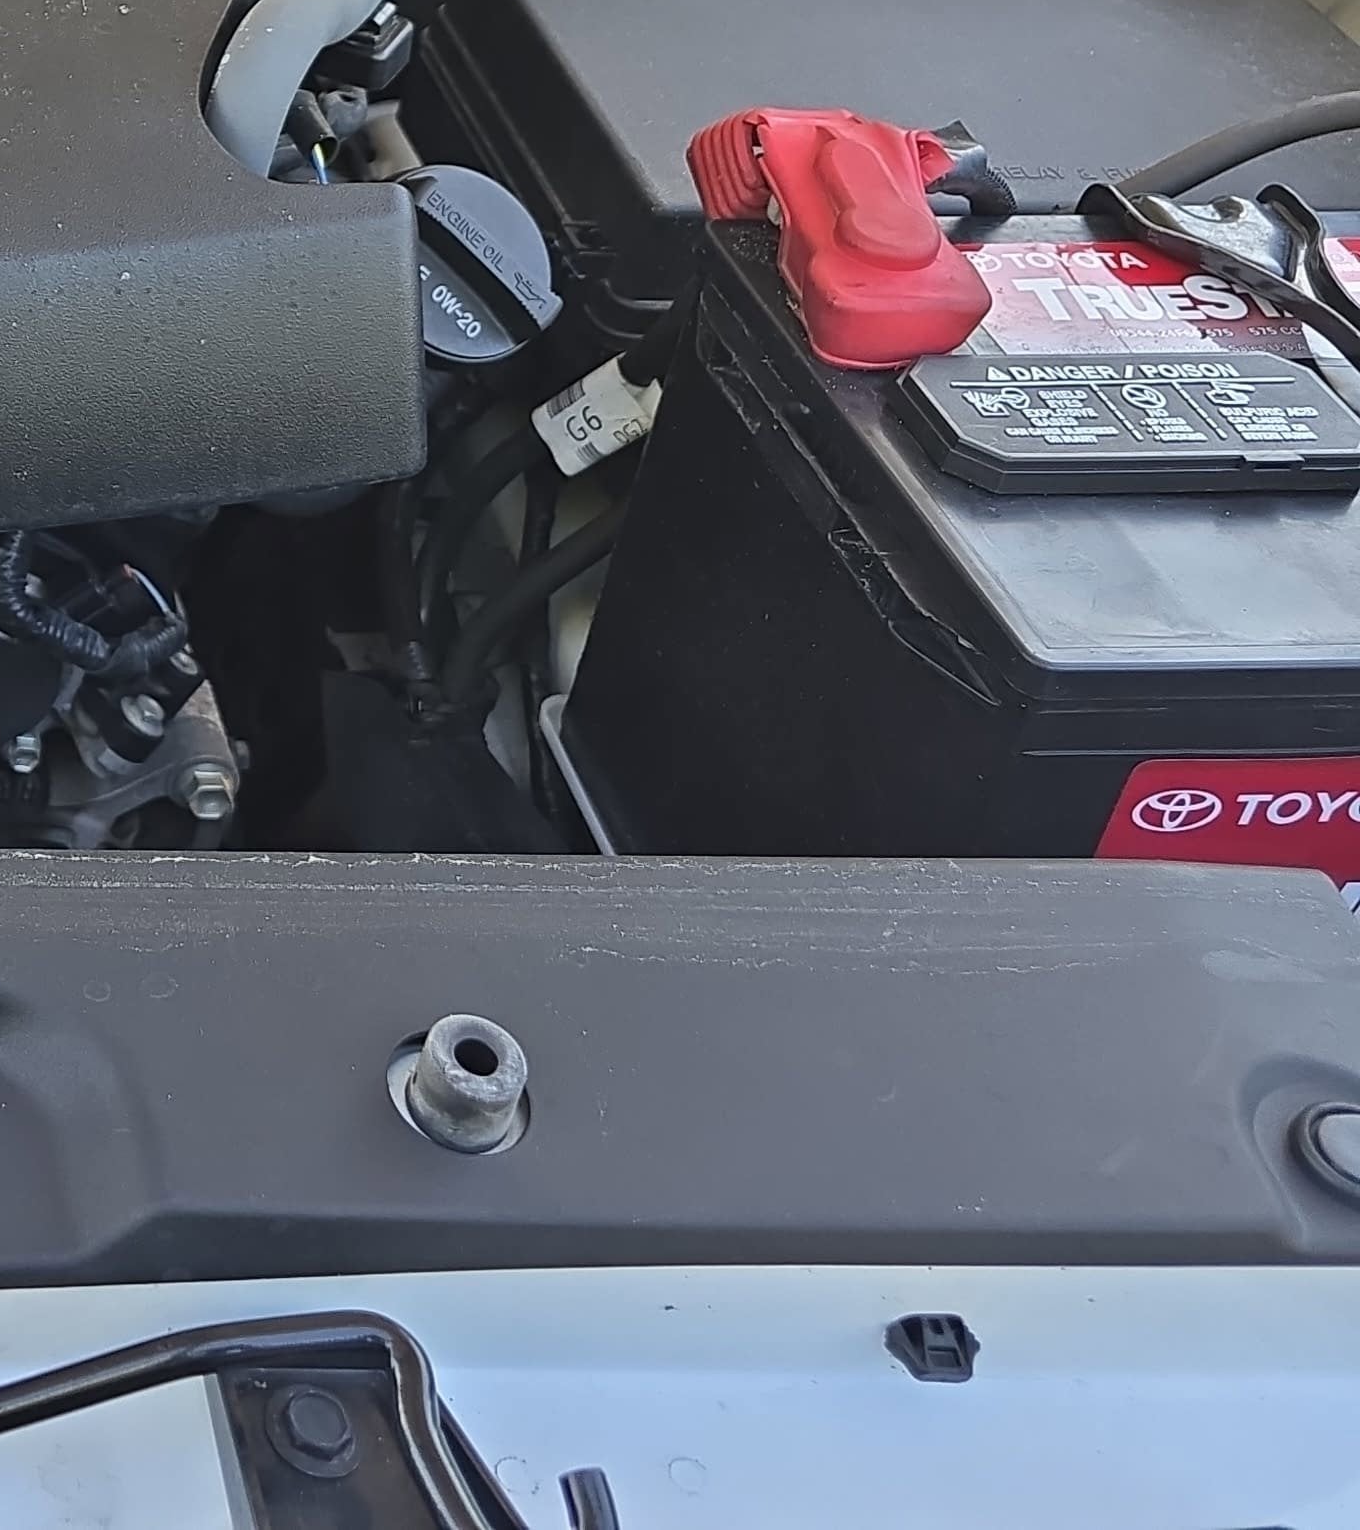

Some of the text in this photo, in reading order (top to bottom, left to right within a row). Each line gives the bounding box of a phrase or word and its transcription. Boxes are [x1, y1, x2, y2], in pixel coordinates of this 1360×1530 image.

[427, 189, 504, 274] ENGINE OIL
[1002, 251, 1149, 270] TOYOTA
[431, 285, 482, 339] 0W-20
[1013, 274, 1293, 321] TRUEST
[1008, 366, 1121, 381] DANGER
[1138, 363, 1241, 378] POISON
[565, 405, 603, 441] G6
[1236, 791, 1360, 825] TOY
